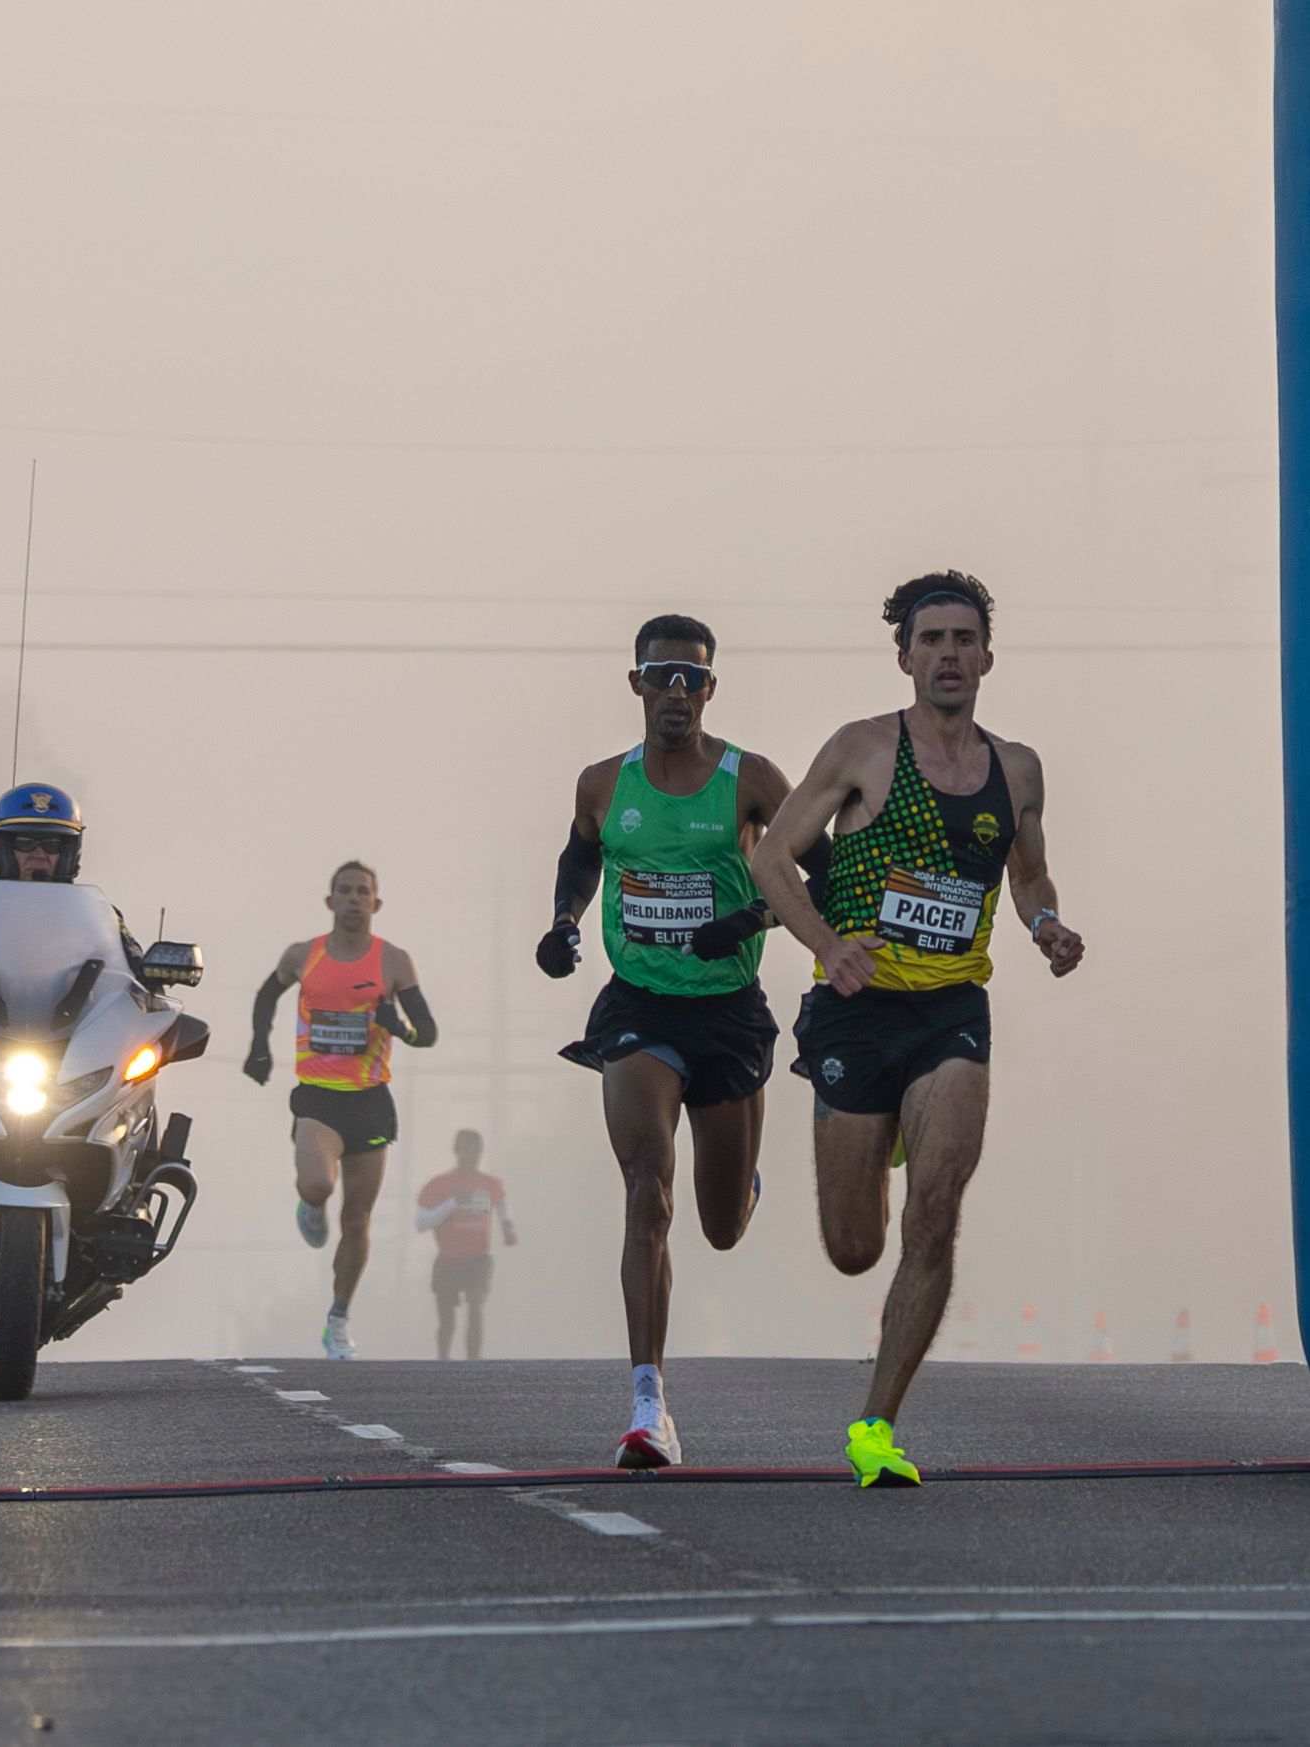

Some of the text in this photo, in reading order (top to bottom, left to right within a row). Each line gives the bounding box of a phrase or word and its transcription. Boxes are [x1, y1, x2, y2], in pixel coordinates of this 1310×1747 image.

[636, 871, 659, 881] 2024
[663, 873, 714, 882] CALIFORNIA
[913, 870, 935, 881] 2024
[941, 876, 985, 891] CALIFORNIA
[648, 881, 713, 890] INTERNATIONAL
[924, 882, 983, 900] INTERNATIONAL
[665, 889, 713, 898] MARATHON
[939, 893, 982, 906] MARATHON
[624, 902, 713, 920] WELDLIBANOS
[895, 898, 967, 932] PACER
[654, 931, 694, 944] ELITE
[917, 933, 956, 952] ELITE
